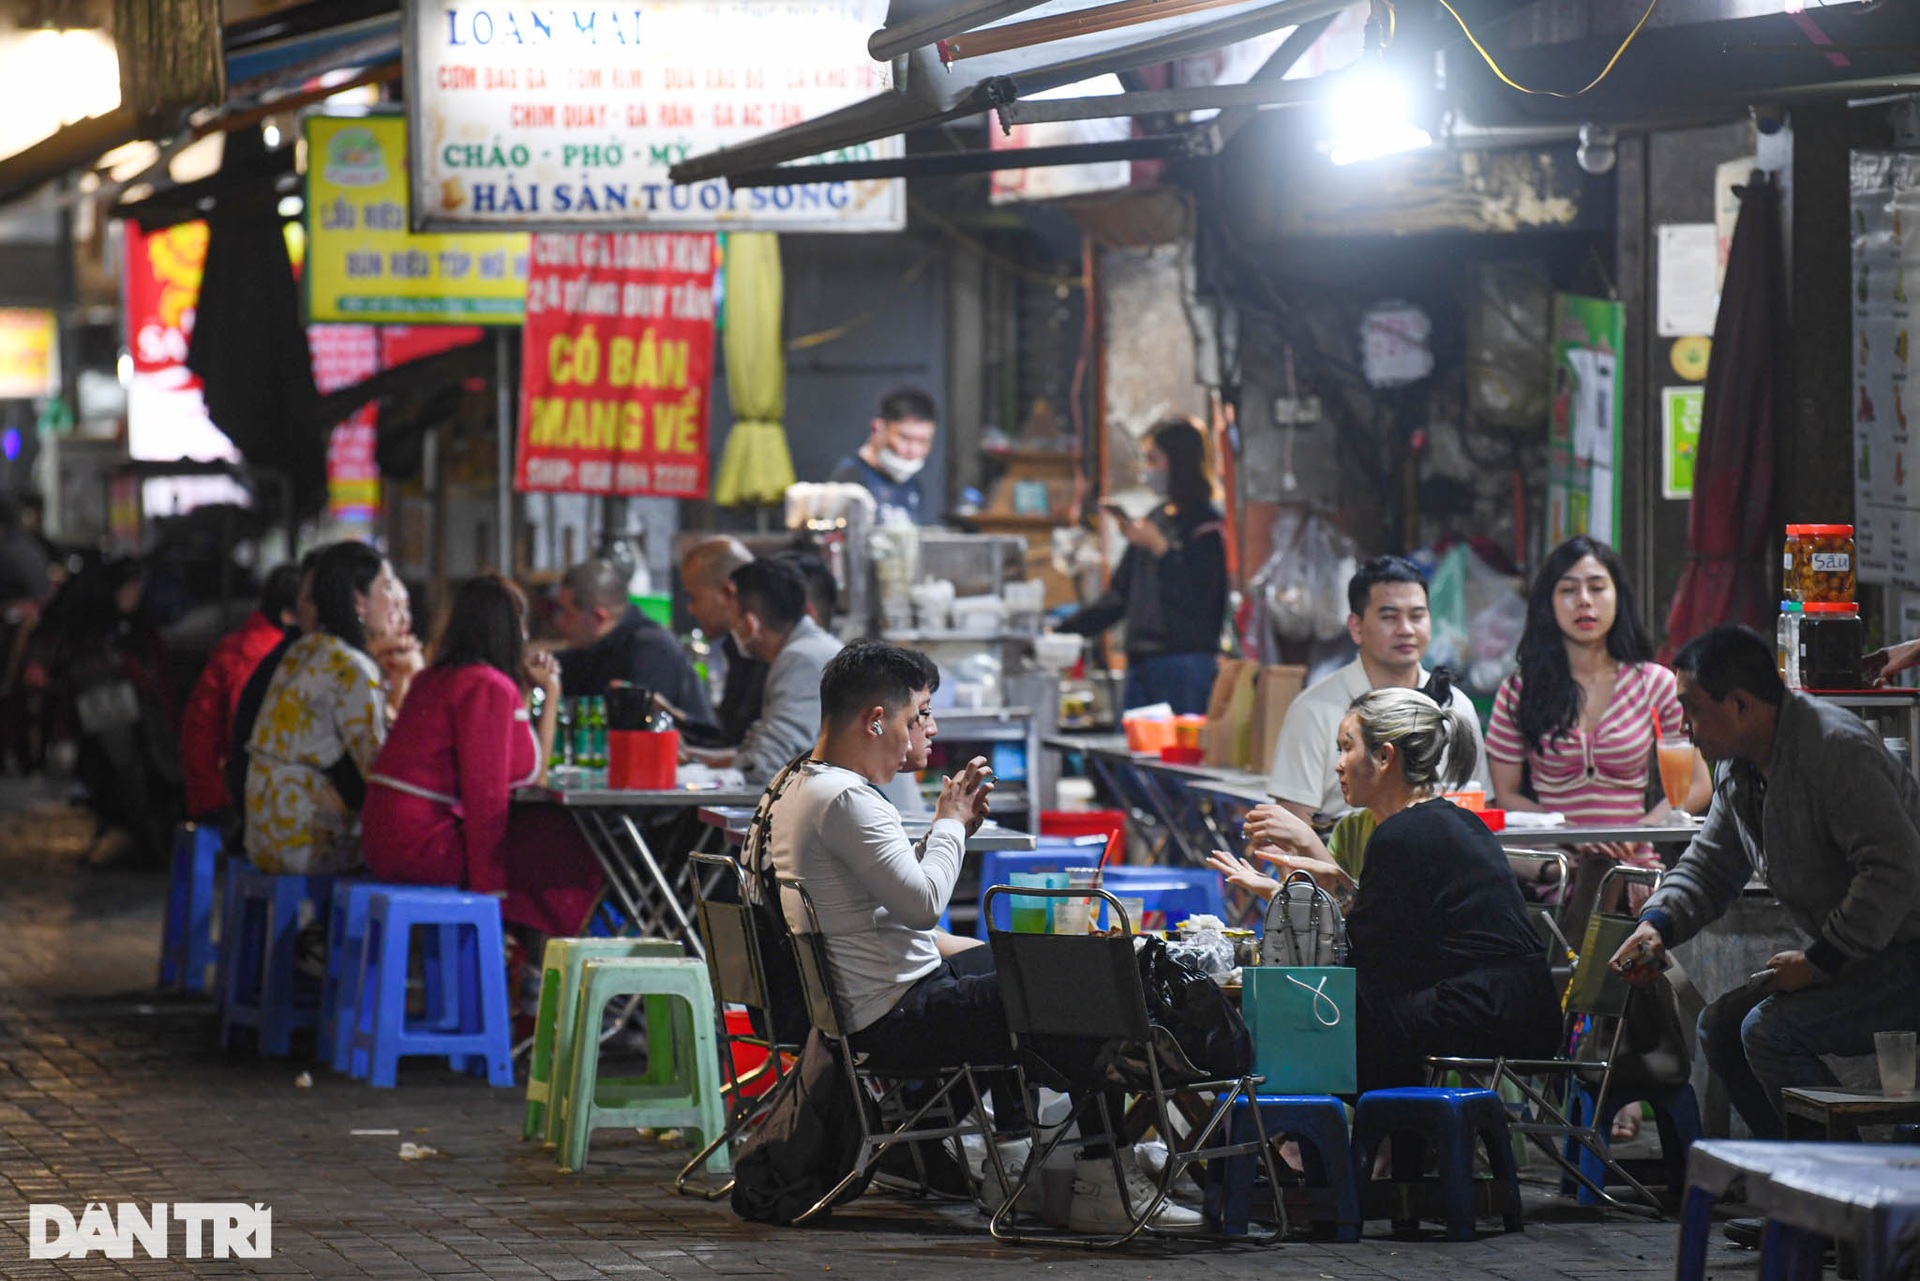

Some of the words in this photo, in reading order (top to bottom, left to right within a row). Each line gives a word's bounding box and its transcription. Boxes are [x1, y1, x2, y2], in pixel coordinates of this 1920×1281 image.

[549, 323, 598, 386] CÓ
[608, 328, 689, 389] BÁN
[530, 396, 644, 450] MANG
